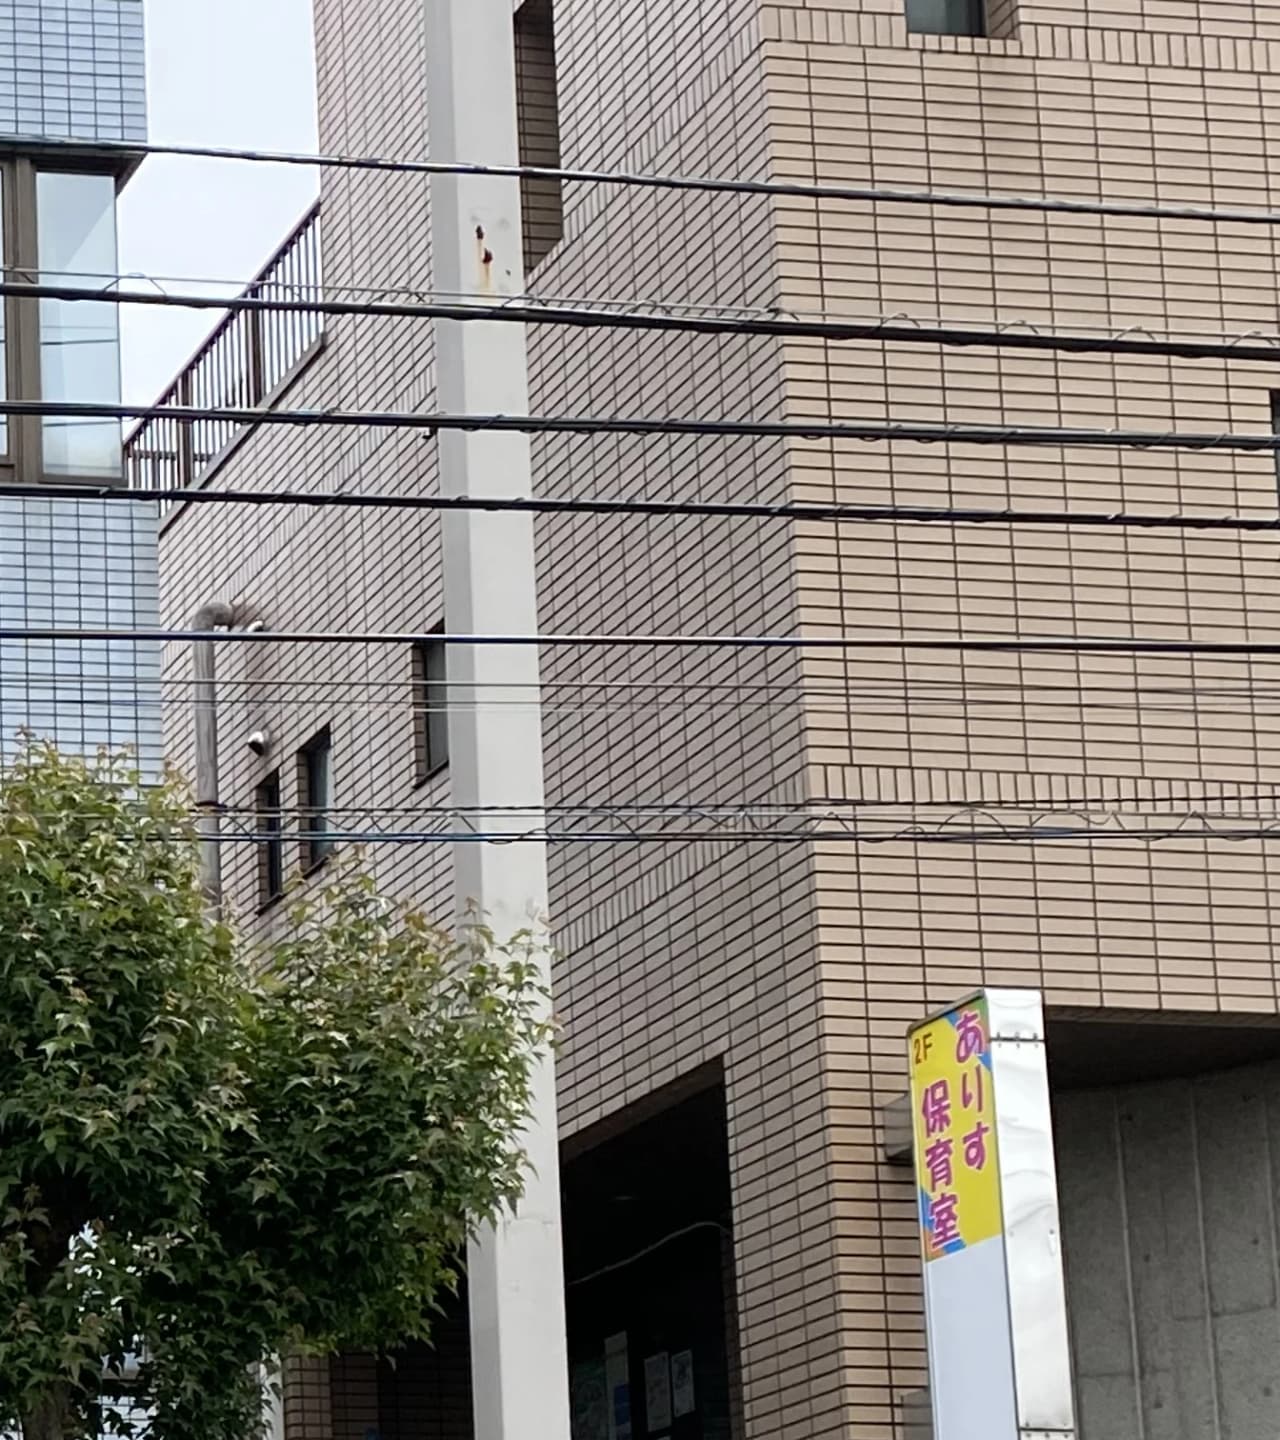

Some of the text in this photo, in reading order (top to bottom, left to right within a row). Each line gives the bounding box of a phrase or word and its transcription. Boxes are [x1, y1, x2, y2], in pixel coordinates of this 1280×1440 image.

[920, 1078, 961, 1250] 保育室
[955, 1008, 991, 1171] ありす
